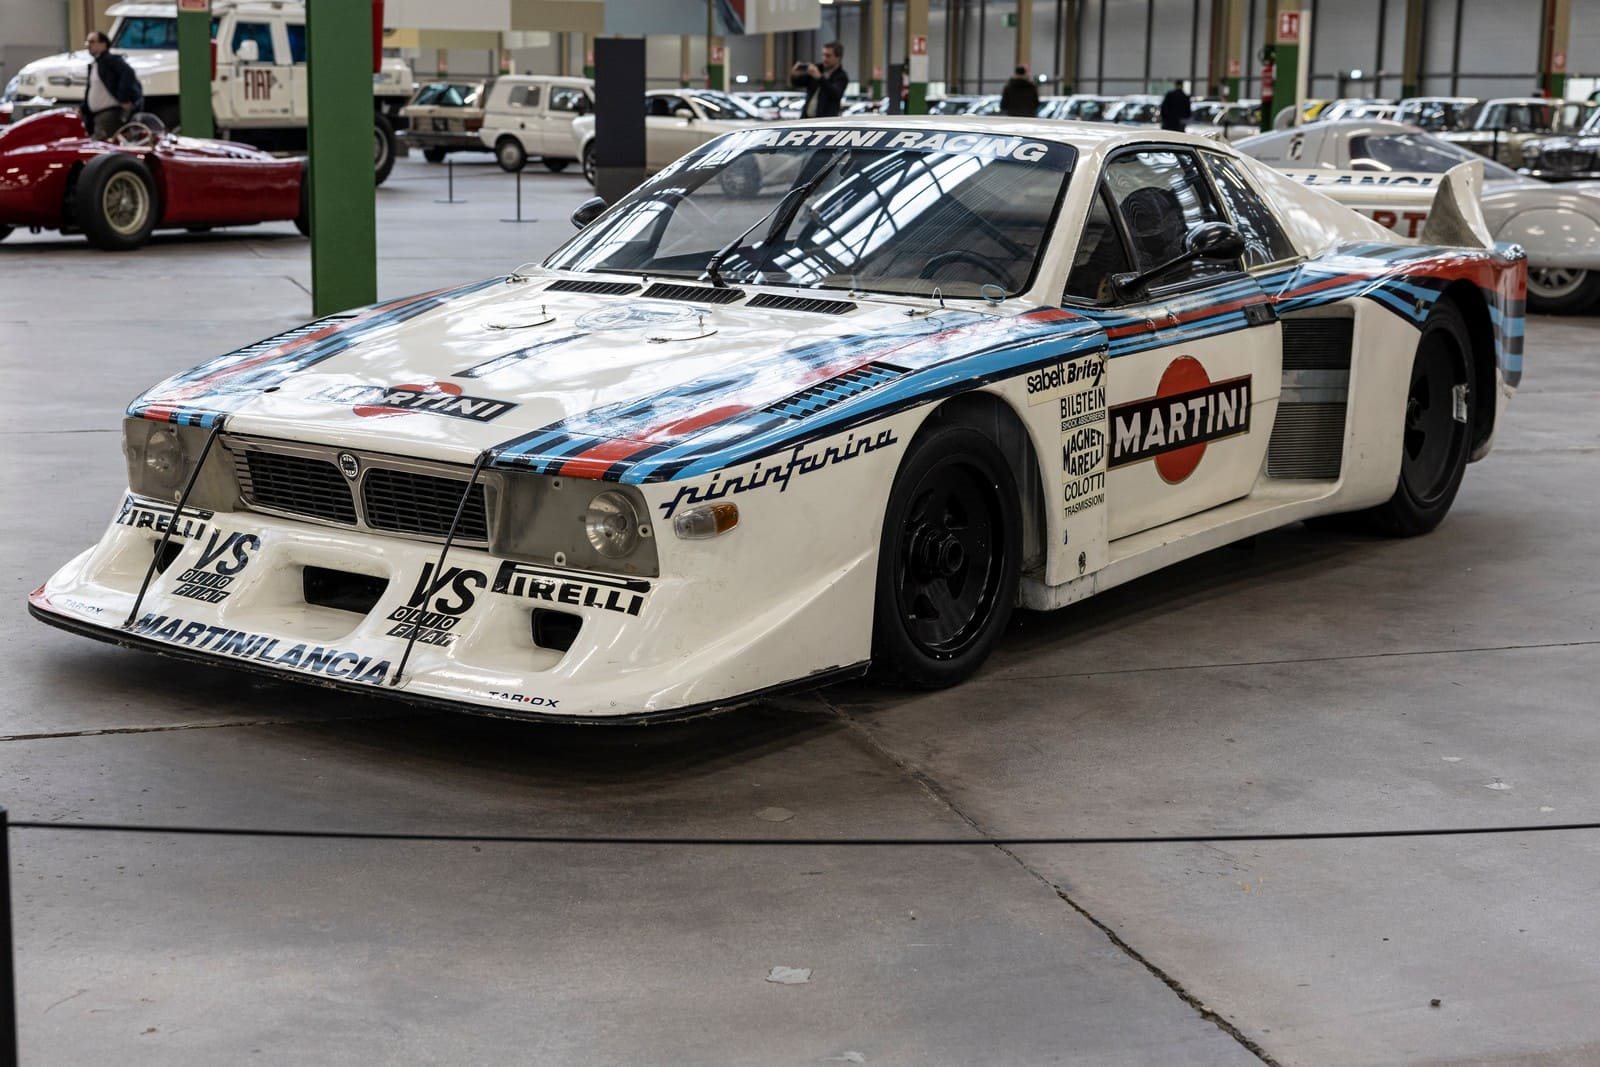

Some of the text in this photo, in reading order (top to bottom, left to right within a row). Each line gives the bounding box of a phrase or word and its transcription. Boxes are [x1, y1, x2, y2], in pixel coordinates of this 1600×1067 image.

[244, 69, 272, 101] FIAT
[728, 129, 1048, 162] ARTINI RACING
[1027, 358, 1105, 394] sabelt Britax
[1060, 388, 1105, 418] BILSTEIN
[1114, 387, 1247, 458] MARTINI
[1063, 429, 1104, 461] MAGNETI
[659, 429, 898, 519] pininfarina
[1063, 452, 1104, 477] MARELLI
[1064, 472, 1104, 502] COLOTTI
[116, 494, 214, 540] PIRELLI
[1064, 494, 1104, 517] TRASMISSIONI
[194, 528, 261, 576] VS
[176, 584, 227, 603] FIAT
[180, 569, 231, 588] OLIO
[406, 562, 488, 615] VS
[491, 560, 651, 616] PIRELLI
[393, 607, 454, 630] OLIO
[136, 613, 391, 684] MARTINI LANCIA
